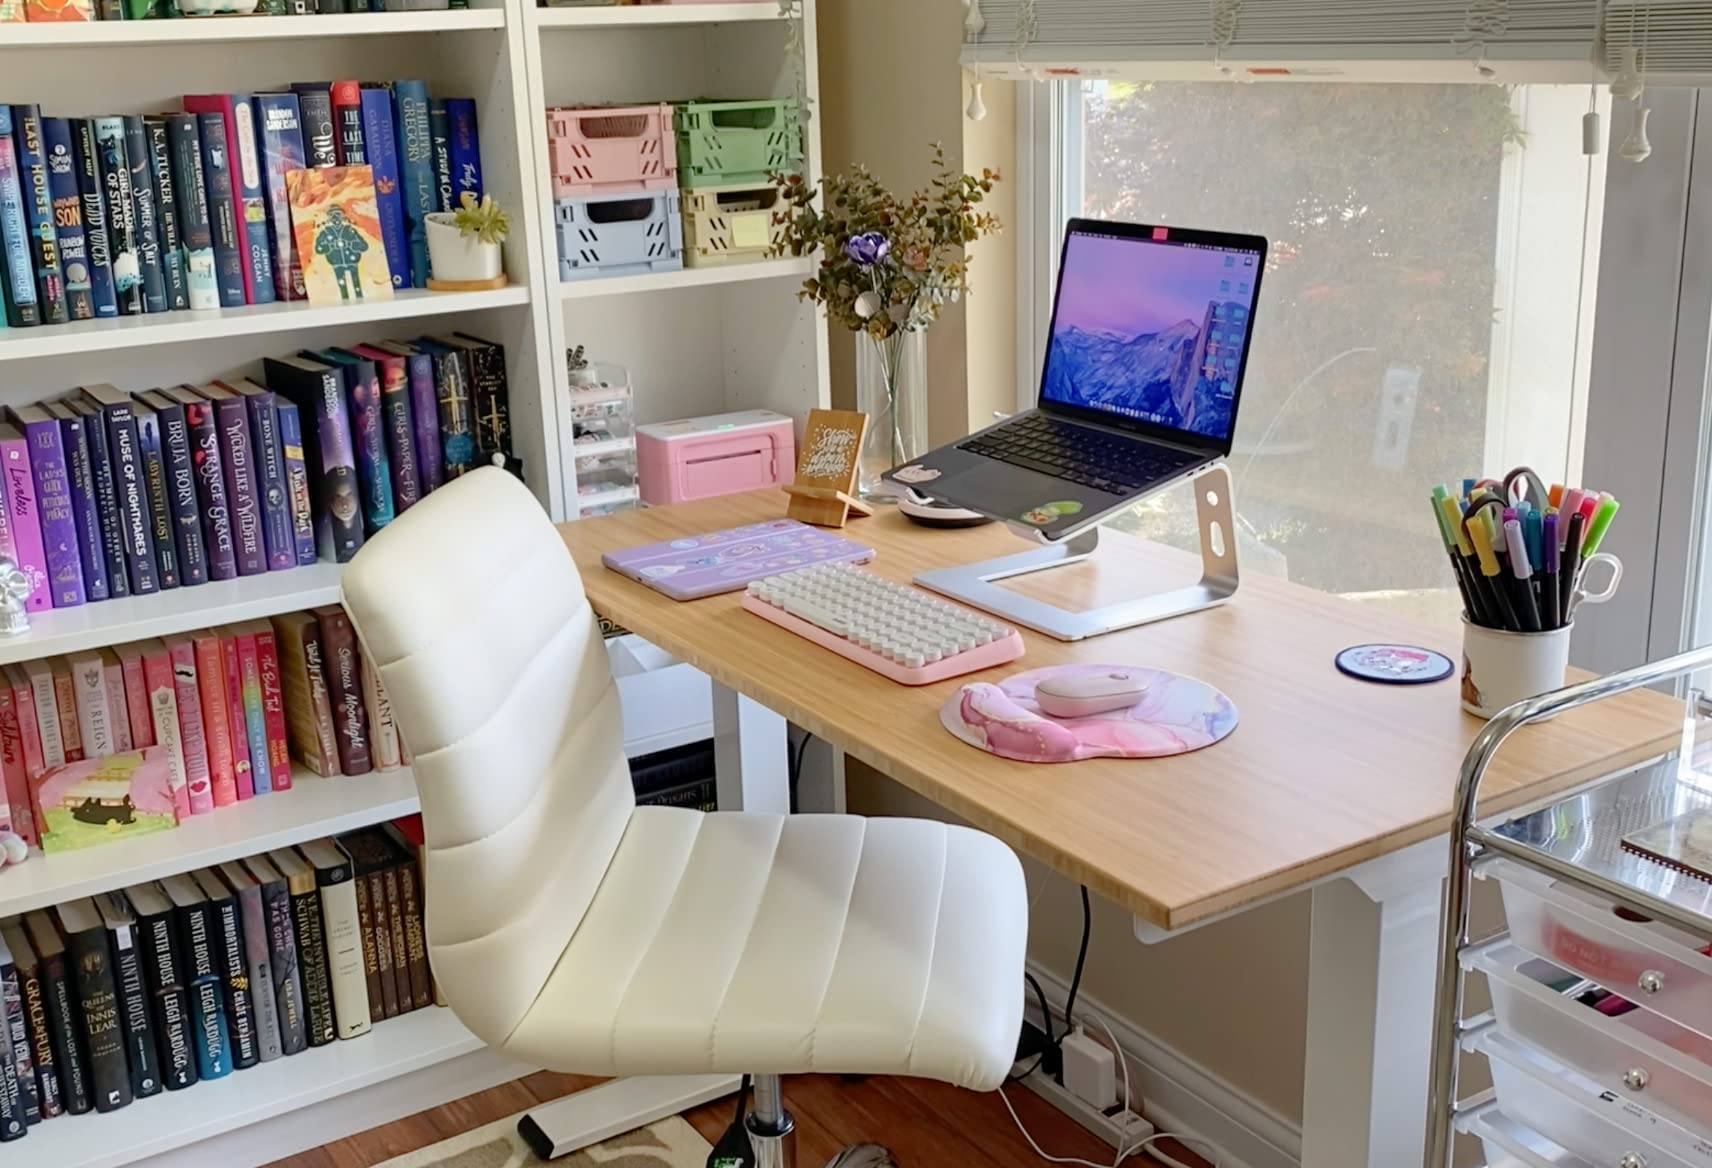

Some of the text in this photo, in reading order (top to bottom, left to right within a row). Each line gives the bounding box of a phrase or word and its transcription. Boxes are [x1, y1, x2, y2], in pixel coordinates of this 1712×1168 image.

[266, 119, 298, 130] SANDERSON
[344, 110, 358, 122] THE
[344, 130, 362, 142] LAST
[382, 120, 392, 156] DIANA
[403, 97, 421, 164] GREGORY
[416, 102, 431, 158] PHILIPPA
[25, 122, 40, 157] LAST
[346, 151, 364, 163] TIME
[369, 110, 382, 169] GABALDON
[434, 136, 450, 175] A STUDY
[2, 177, 17, 204] SWIPE
[32, 164, 48, 215] HOUSE
[118, 168, 130, 198] GIRL
[157, 154, 172, 204] TUCKER
[460, 164, 478, 189] Truly
[8, 208, 22, 235] RIGHT
[56, 206, 80, 226] SON
[107, 173, 124, 230] OF STARS
[133, 188, 152, 228] SUMMER
[40, 222, 57, 270] GUEST
[84, 193, 110, 267] DEAD VOICES
[386, 202, 398, 264] OUTLANDER
[141, 242, 158, 266] SALT
[252, 244, 262, 282] COLGAN
[262, 248, 270, 277] JENNY
[16, 258, 31, 296] MURDER
[166, 420, 193, 505] BRUJA BORN
[227, 419, 247, 465] WICKED
[262, 419, 276, 477] BONE WITCH
[393, 402, 416, 505] GIRLS PAPER FIRE
[10, 468, 31, 516] Loveless
[83, 476, 91, 498] MOON
[118, 429, 145, 555] MUSE OF NIGHTMARES
[147, 451, 163, 510] LABYRINTH
[157, 516, 167, 539] LOST
[201, 433, 231, 552] STRANGE GRACE
[235, 468, 247, 490] LIKE
[293, 473, 309, 531] Wish Dark
[112, 532, 121, 562] OTHER
[237, 500, 259, 553] WILDFIRE
[262, 655, 274, 669] The
[245, 656, 265, 774] SOMEWHERE ONLY WE KNOW
[337, 646, 364, 748] Serious Moonlight
[90, 710, 107, 750] REIGN
[162, 717, 175, 758] CUPCAKE
[278, 740, 287, 763] HELEN
[269, 740, 279, 766] HOANG
[271, 925, 286, 952] GONE
[295, 898, 311, 945] SCHWAB
[404, 915, 417, 962] RAMPANT
[411, 915, 423, 957] LIONESS
[364, 927, 377, 972] ALANNA
[375, 927, 386, 971] GODDESS
[119, 954, 146, 1032] NINTH HOUSE
[189, 911, 222, 1057] NINTH HOUSE LEIGH BARDUGO
[223, 913, 249, 1058] IMMORTALISTS CHLOE BENJAMIN
[310, 917, 332, 1027] THE INVISIBLE LIFE
[82, 993, 114, 1010] QUEENS
[153, 921, 186, 1068] NINTH HOUSE LEIGH BARDUGO
[284, 978, 297, 1027] LISA JEWELL
[303, 948, 323, 1042] OF ADDIE LARUE
[56, 981, 83, 1094] SPELLBOOK LOST FOUND
[86, 1010, 116, 1024] INNIS
[90, 1019, 117, 1034] LEAR
[10, 1021, 30, 1061] MUD VEIN
[5, 1065, 18, 1097] DEATH
